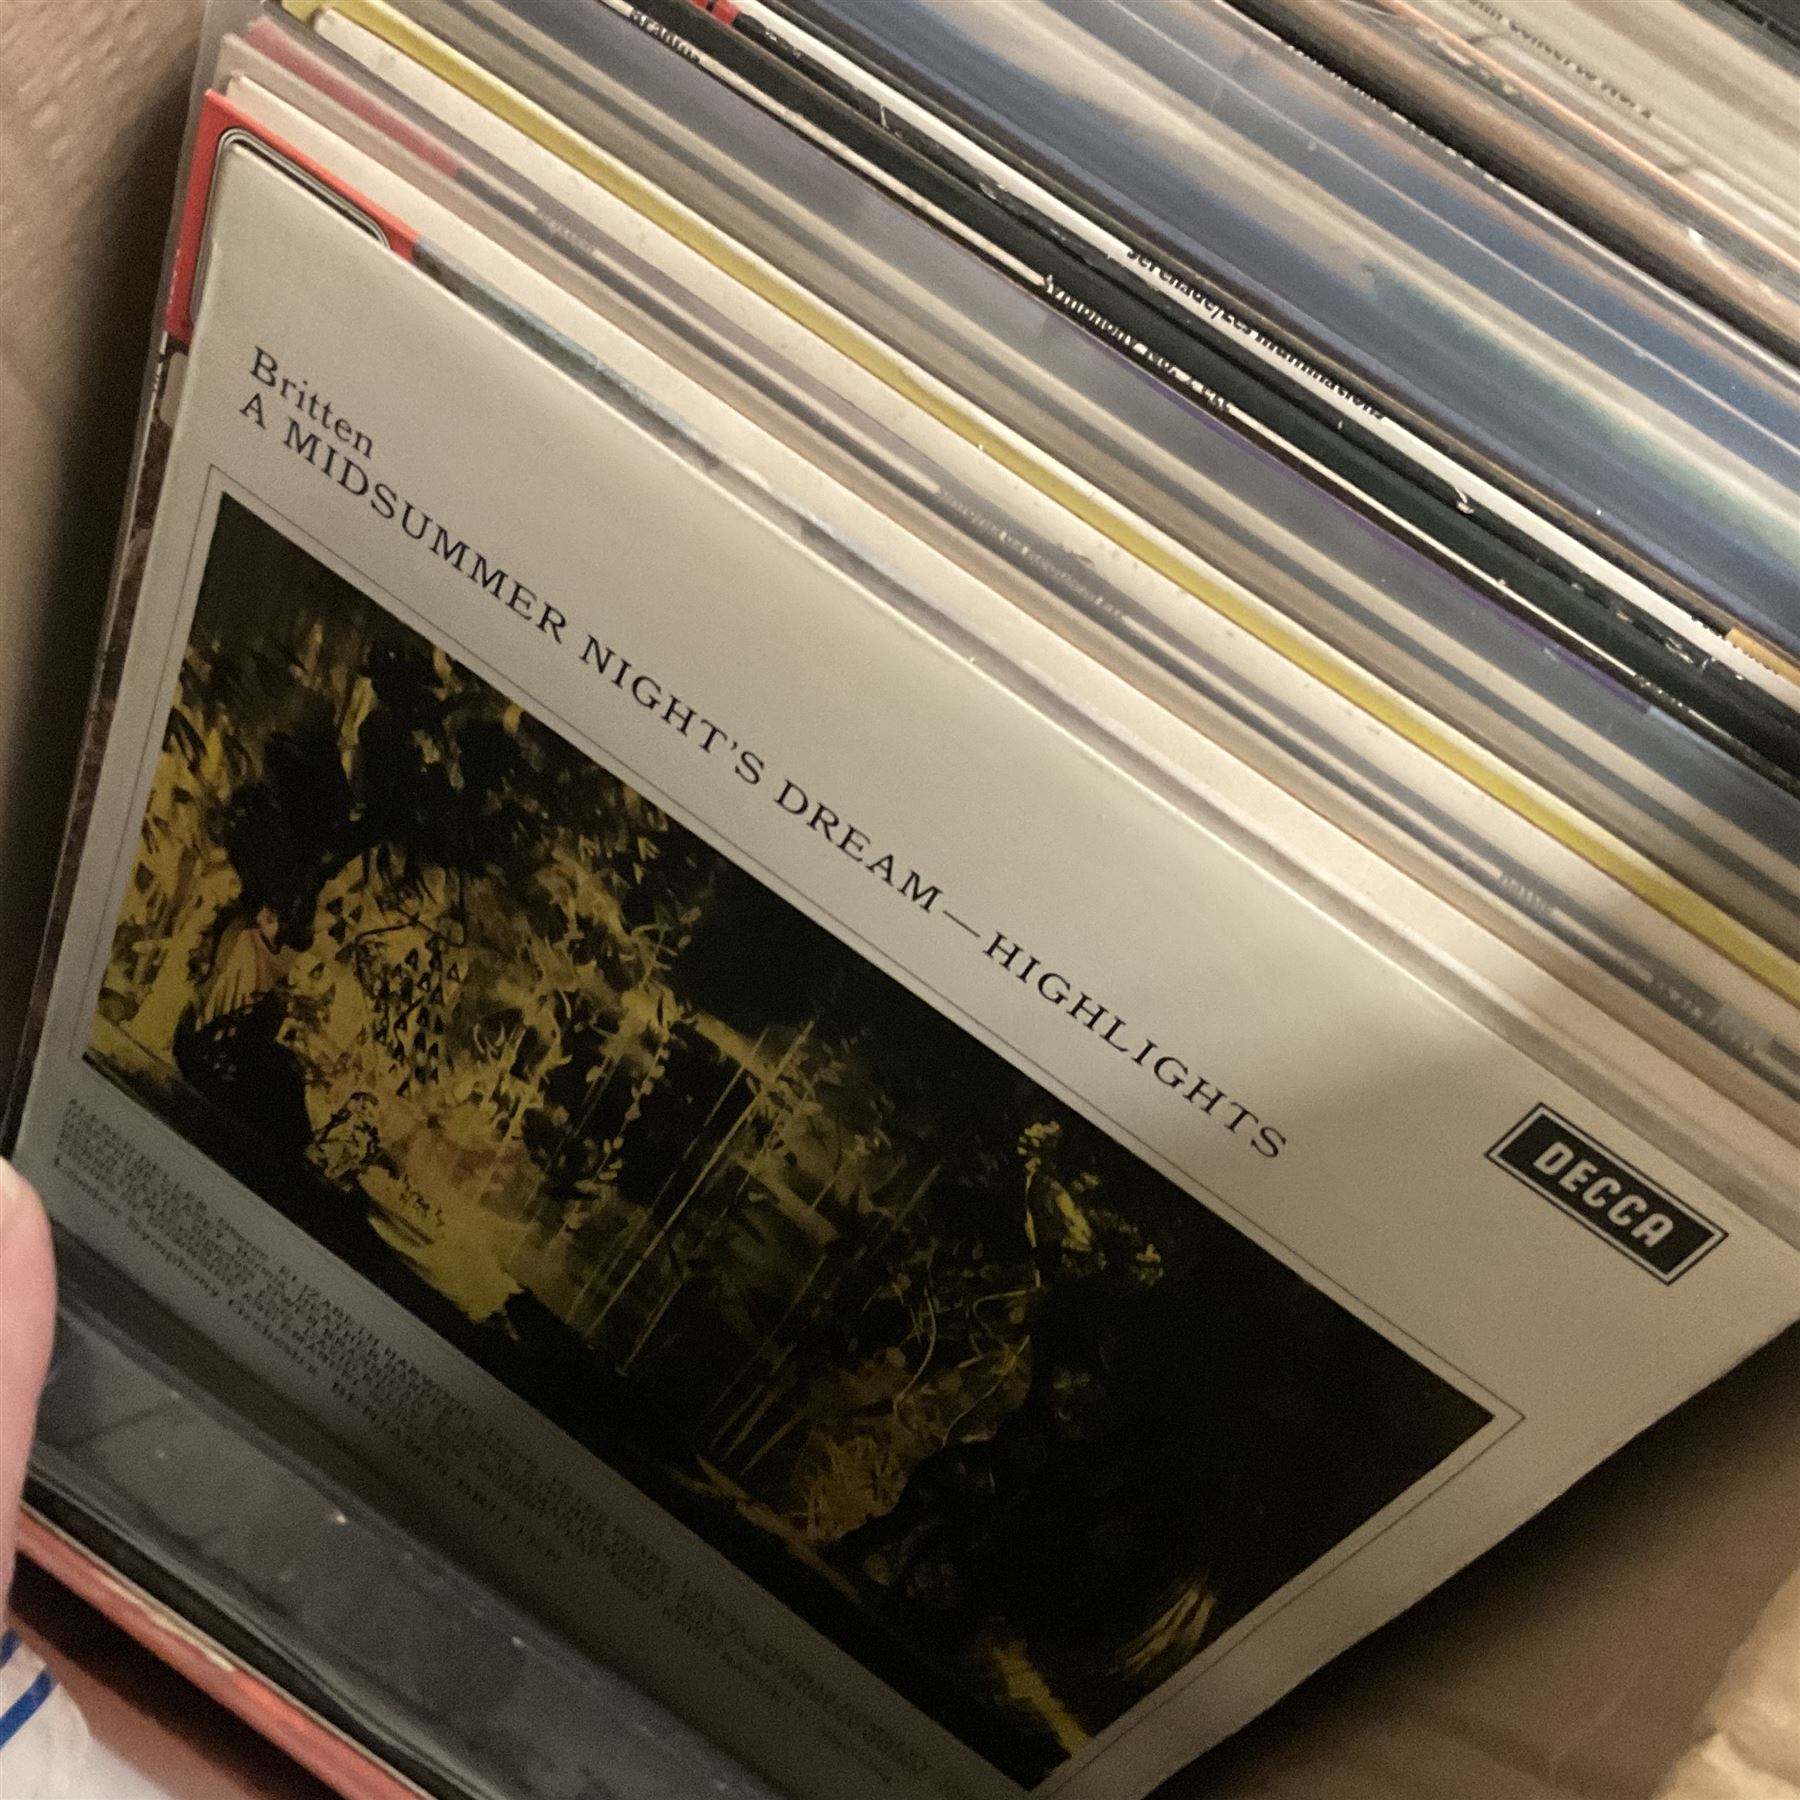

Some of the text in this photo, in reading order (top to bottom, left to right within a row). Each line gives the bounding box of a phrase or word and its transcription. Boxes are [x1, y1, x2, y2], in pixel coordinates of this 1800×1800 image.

[249, 346, 374, 460] Britten
[238, 393, 267, 431] A
[282, 416, 568, 645] MIDSUMMER
[578, 634, 765, 786] NIGHT'S
[1532, 1140, 1675, 1249] DECCA
